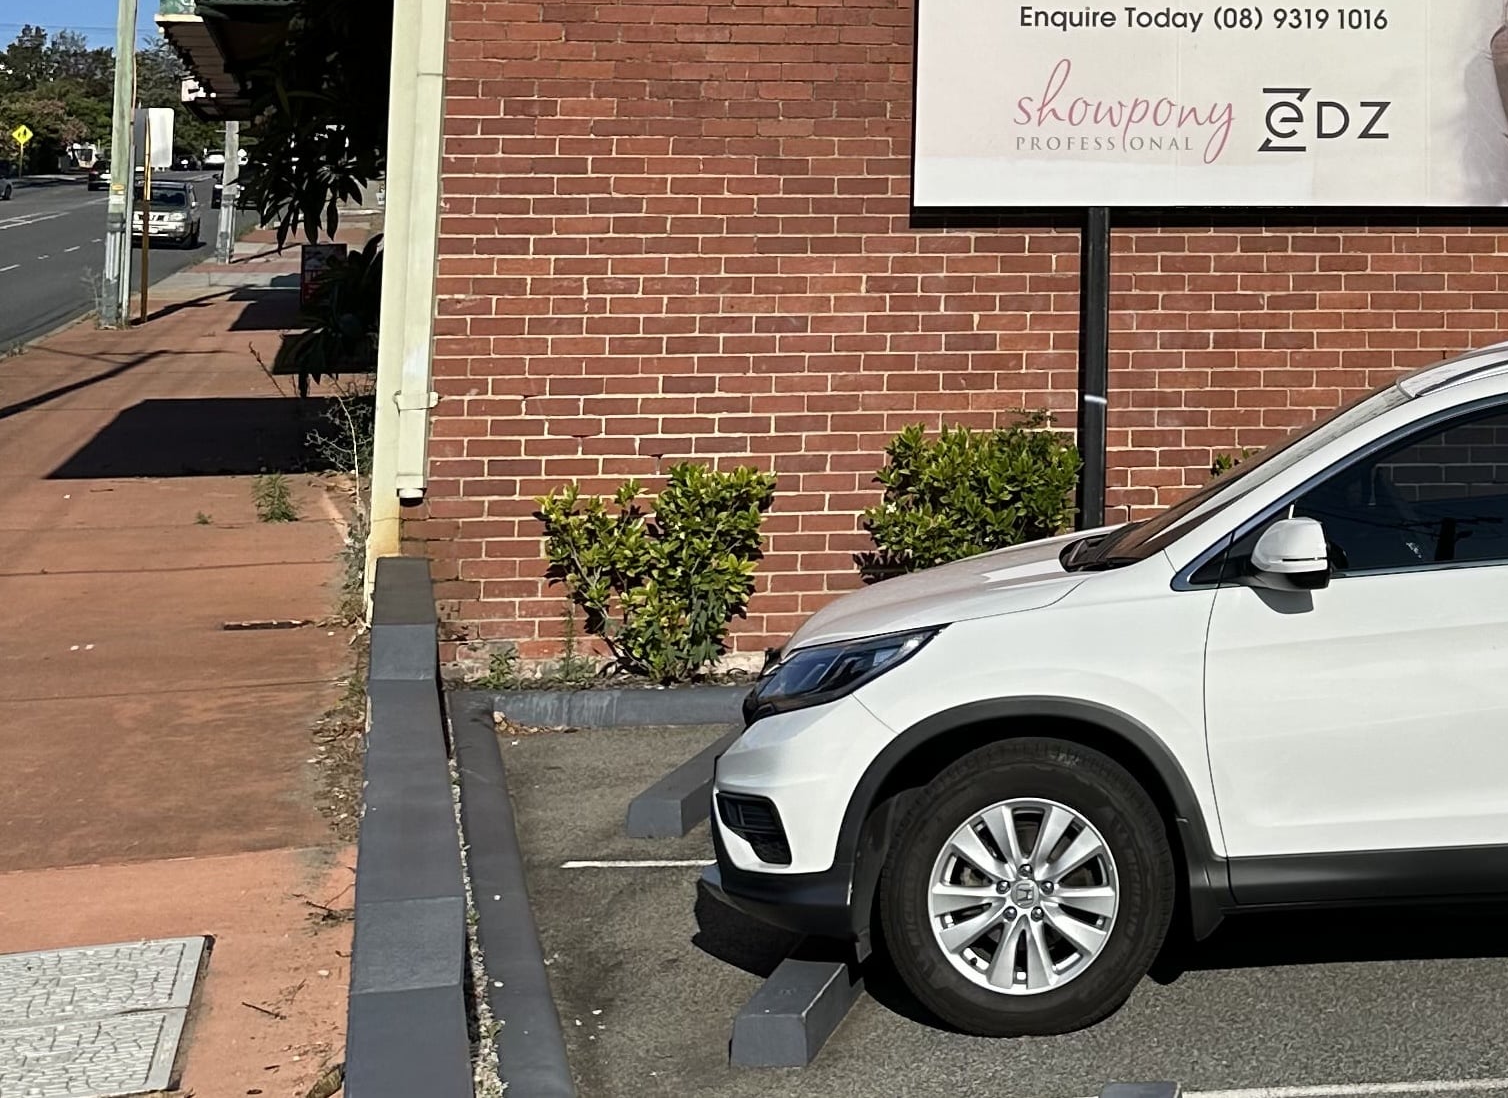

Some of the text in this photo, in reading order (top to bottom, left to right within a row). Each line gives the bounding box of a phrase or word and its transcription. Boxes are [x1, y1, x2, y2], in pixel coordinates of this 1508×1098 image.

[1019, 6, 1388, 32] Enquire Today (08) 9319 1016
[1013, 58, 1235, 164] showpony
